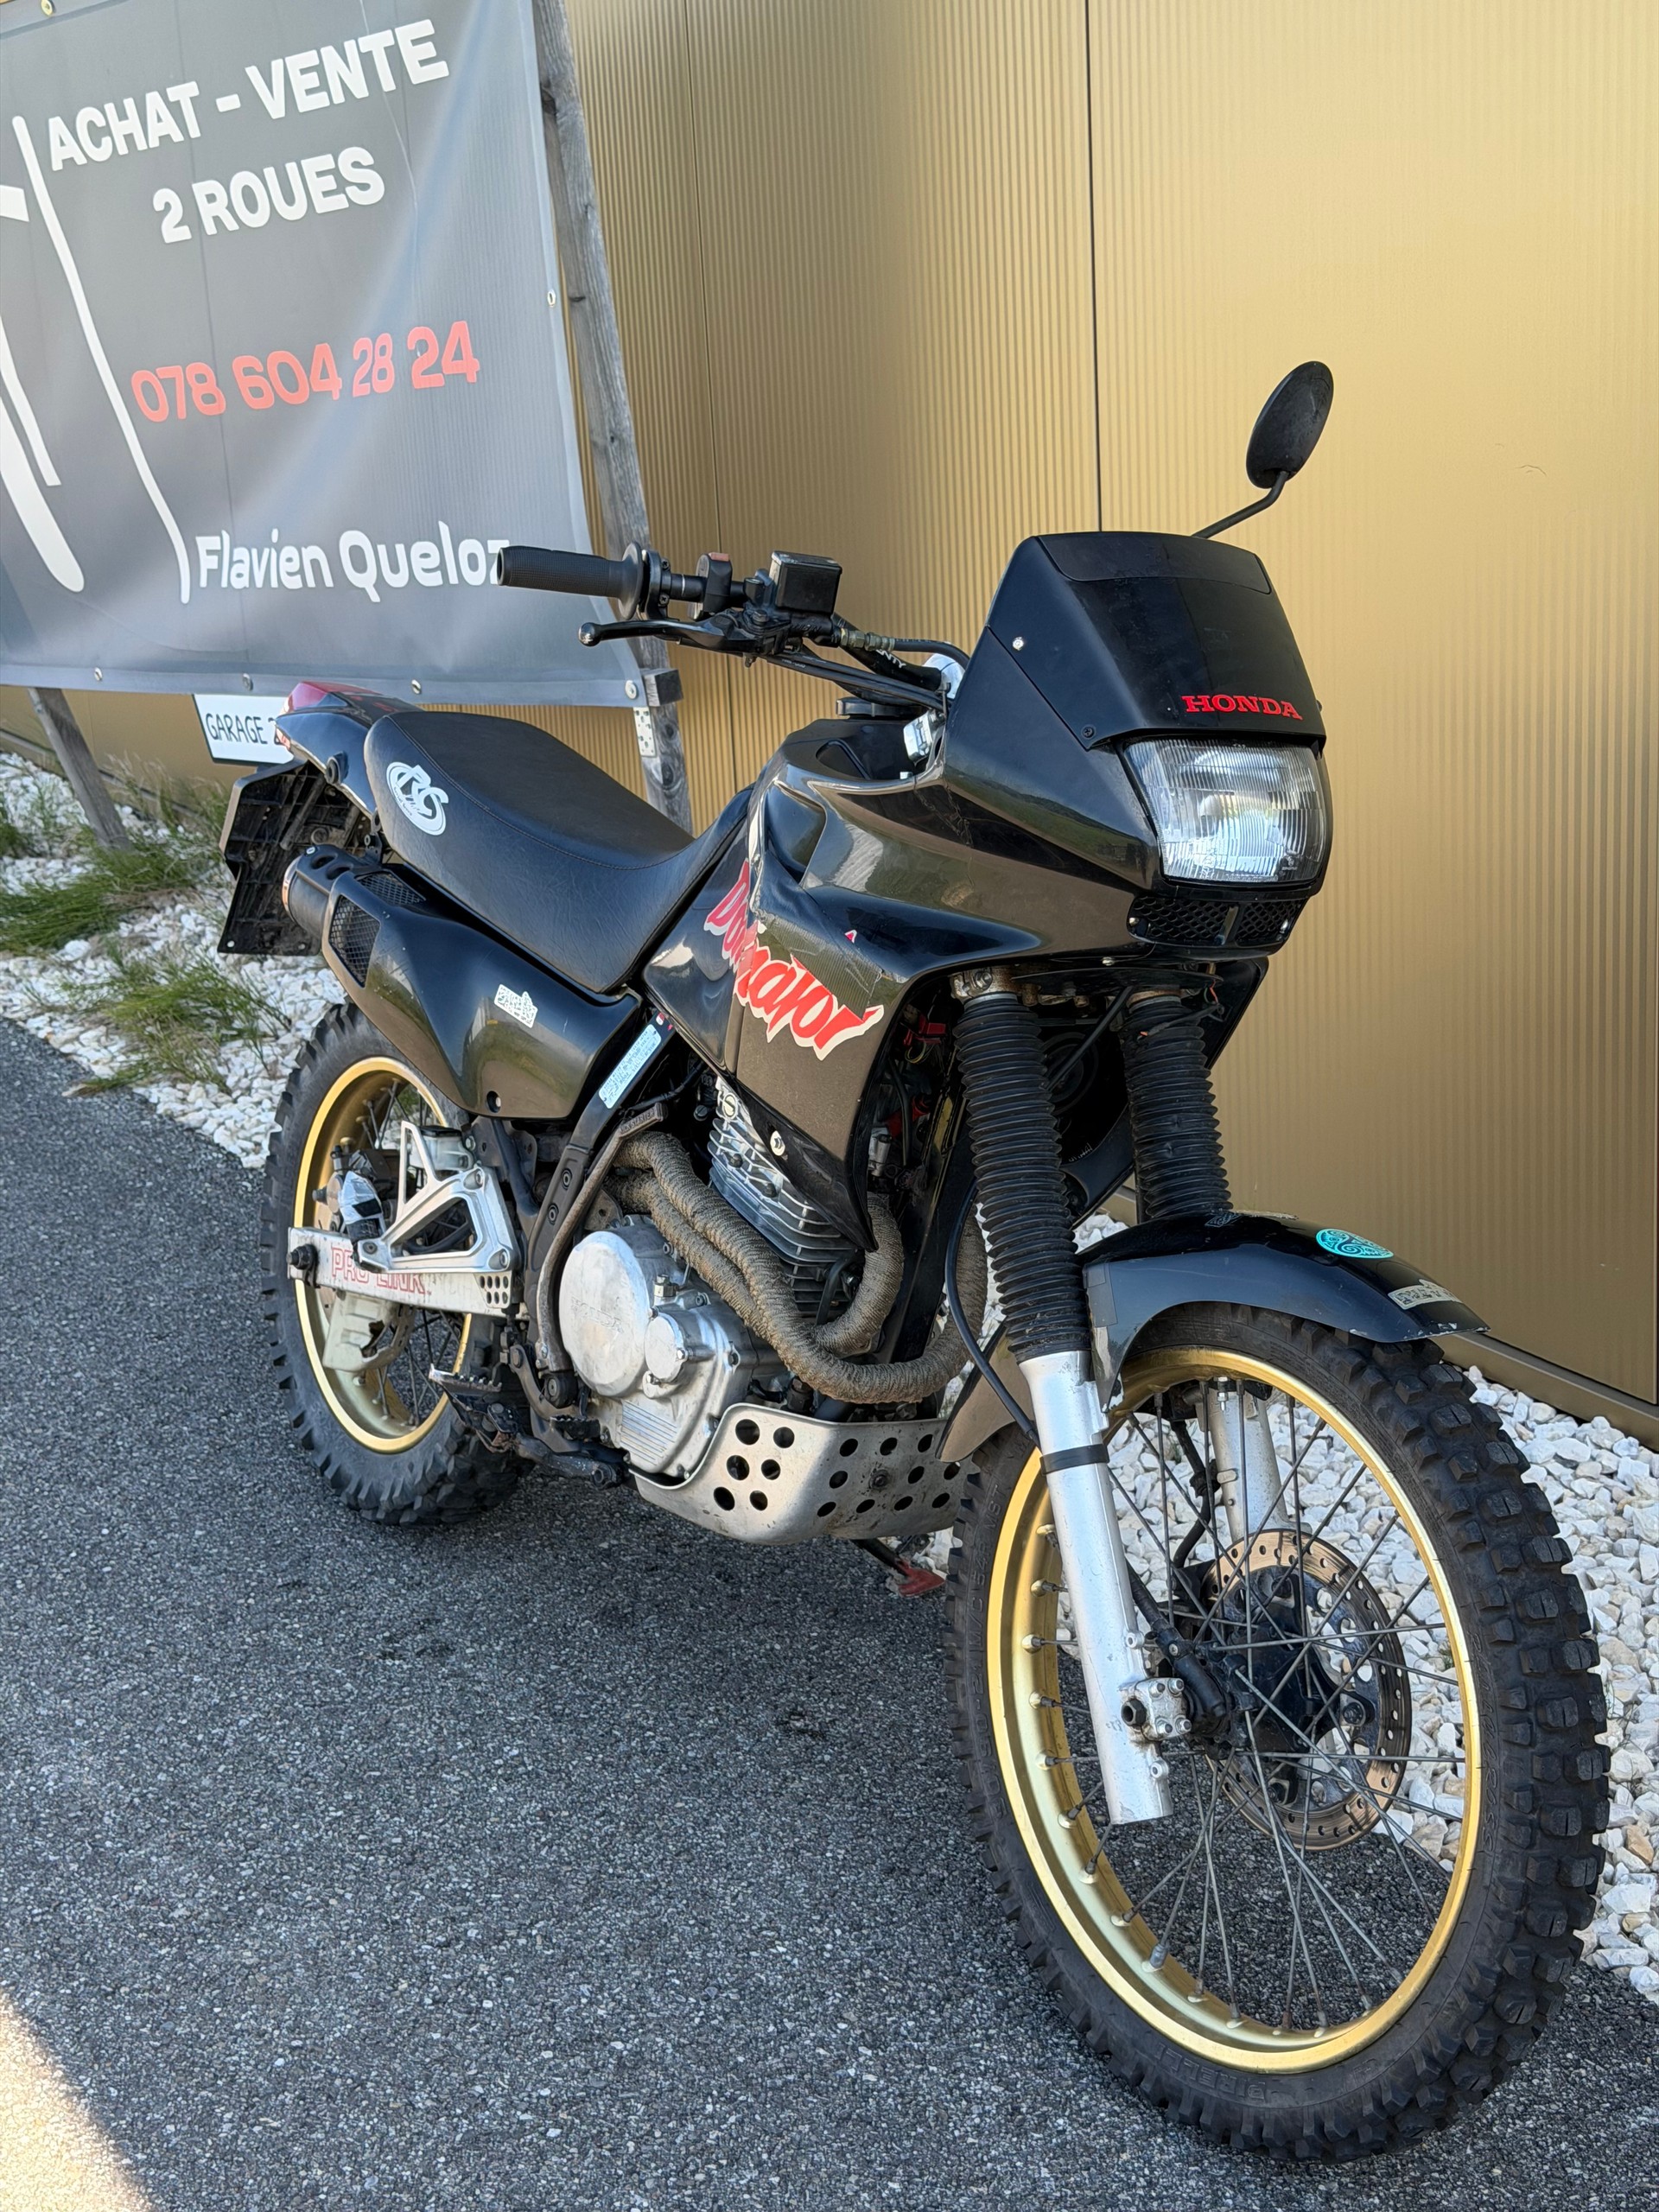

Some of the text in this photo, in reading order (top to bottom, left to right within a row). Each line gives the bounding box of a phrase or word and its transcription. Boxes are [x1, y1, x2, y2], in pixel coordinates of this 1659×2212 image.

[48, 19, 449, 171] ACHAT - VENTE
[153, 146, 385, 244] 2 ROUES
[132, 321, 480, 422] 078 604 28 24
[195, 528, 334, 589] Flavien
[205, 712, 268, 745] GARAGE
[1181, 694, 1303, 721] HONDA
